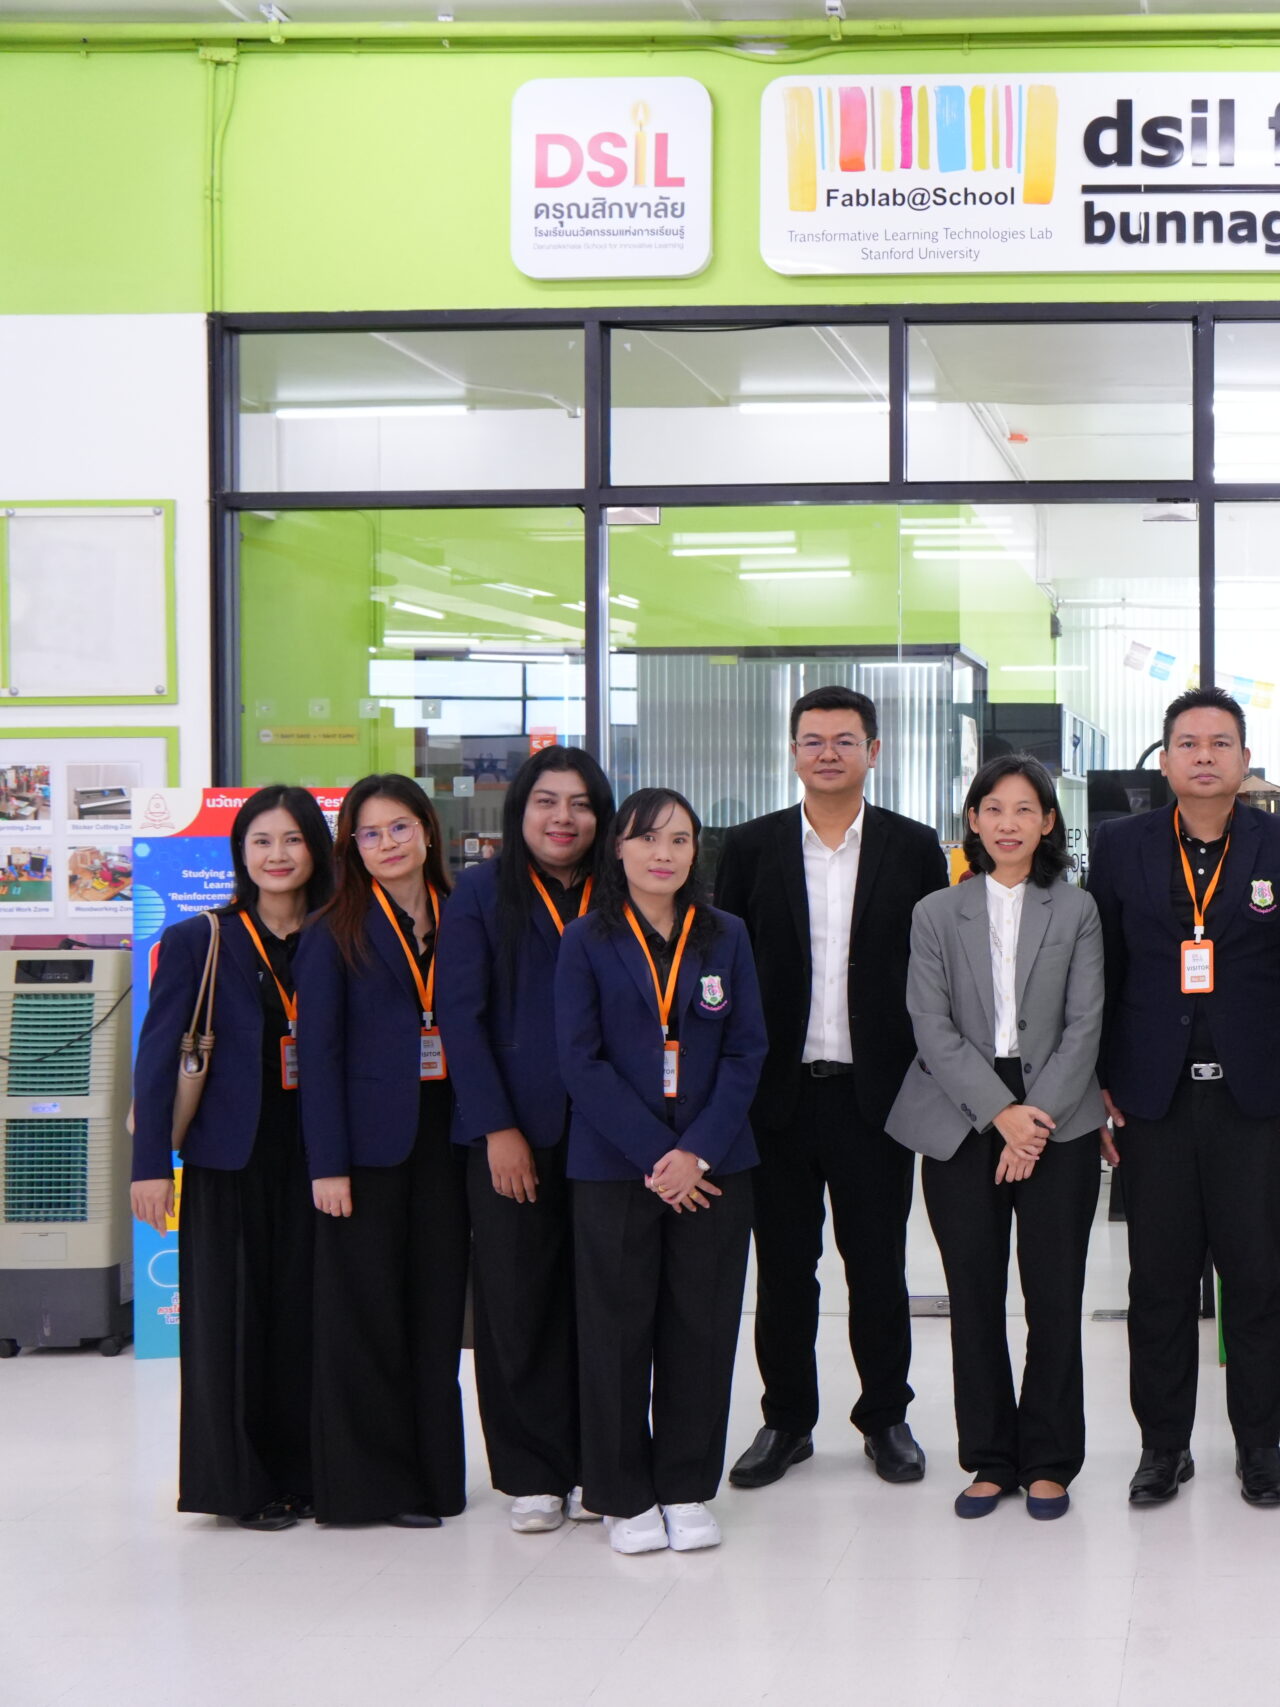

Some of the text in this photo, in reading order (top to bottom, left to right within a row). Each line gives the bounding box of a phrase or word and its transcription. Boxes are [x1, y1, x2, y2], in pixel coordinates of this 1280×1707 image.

[1084, 99, 1235, 168] dsil
[826, 187, 1015, 212] Fablab@School
[534, 195, 685, 228] ดรุณสิกขาลัย
[788, 227, 1053, 243] Transformative Learning Technologies Lab
[860, 246, 980, 262] Stanford University
[181, 869, 225, 879] Studying
